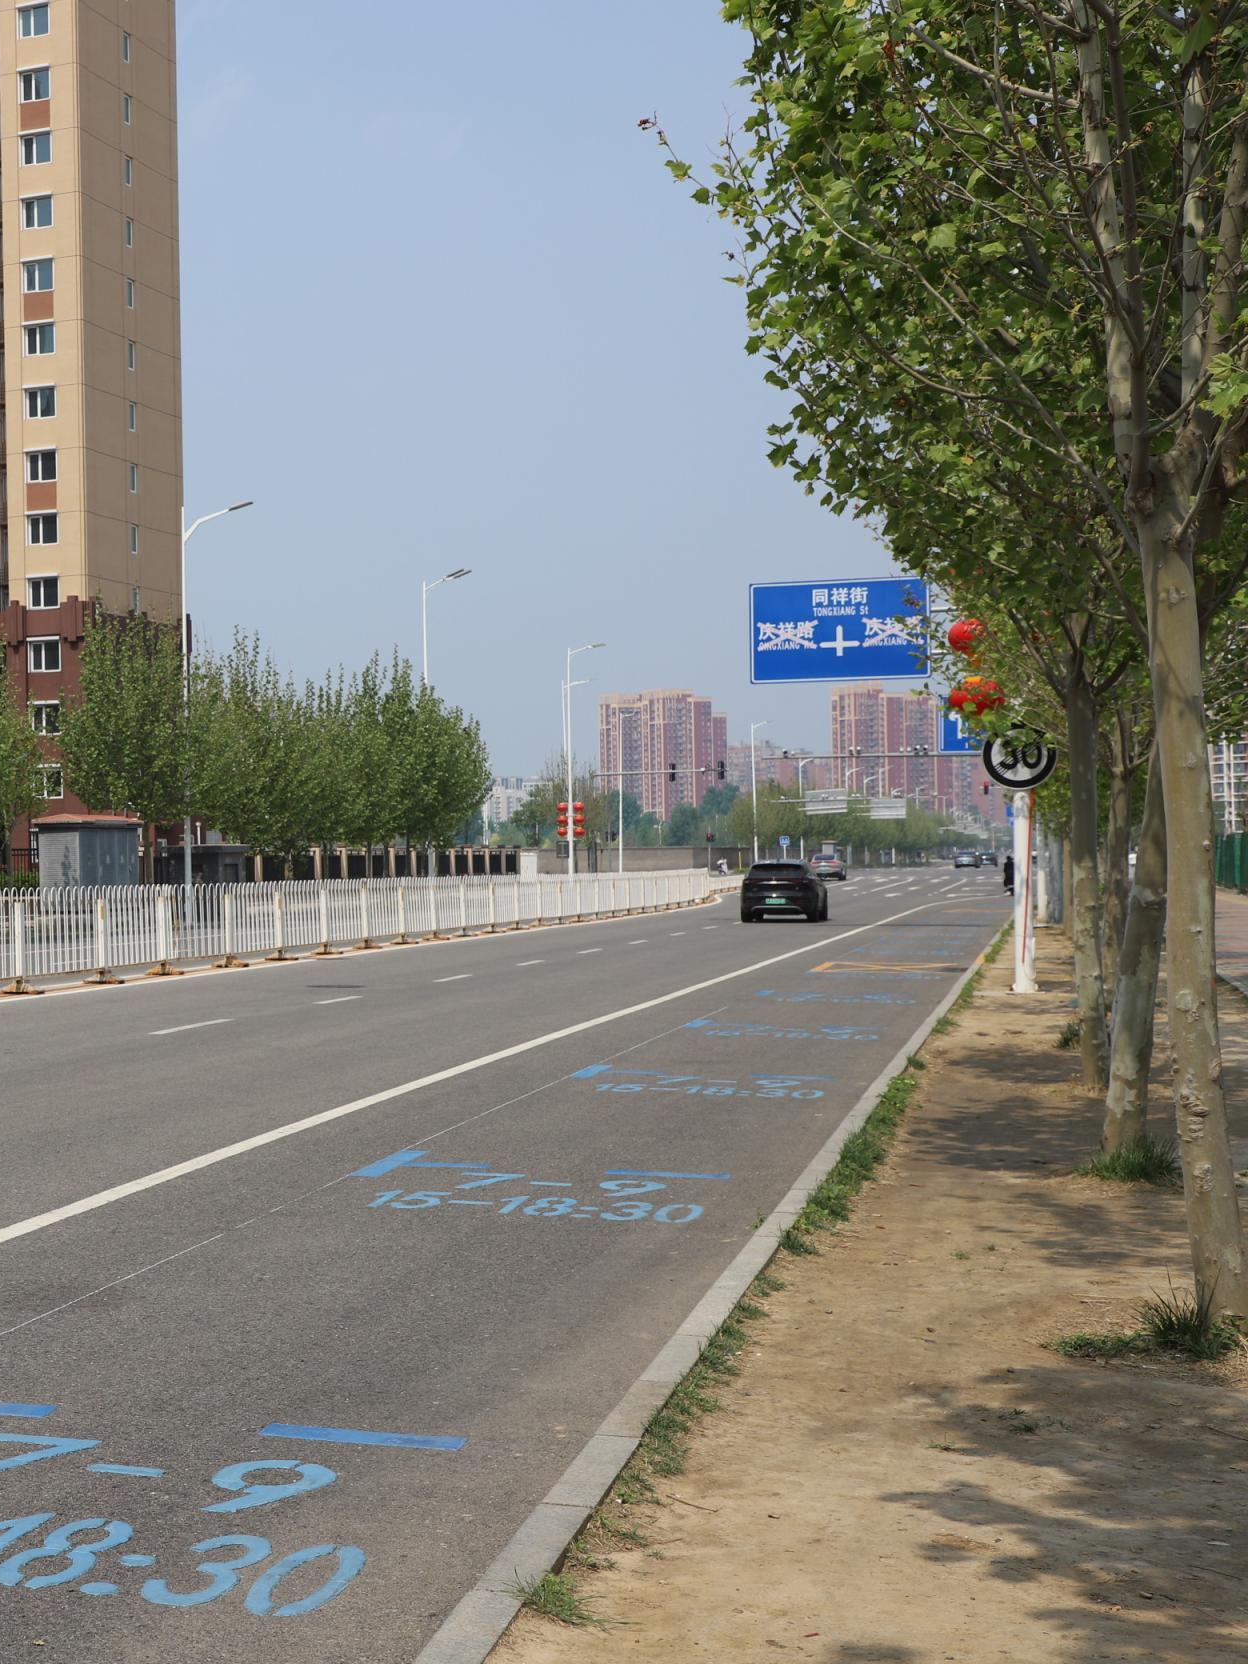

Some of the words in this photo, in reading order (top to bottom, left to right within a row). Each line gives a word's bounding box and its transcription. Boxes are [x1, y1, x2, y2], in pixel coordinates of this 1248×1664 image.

[812, 587, 868, 606] 同祥街
[813, 606, 856, 617] TONGXIANG
[860, 605, 869, 615] St
[367, 1189, 705, 1224] 15-18:30
